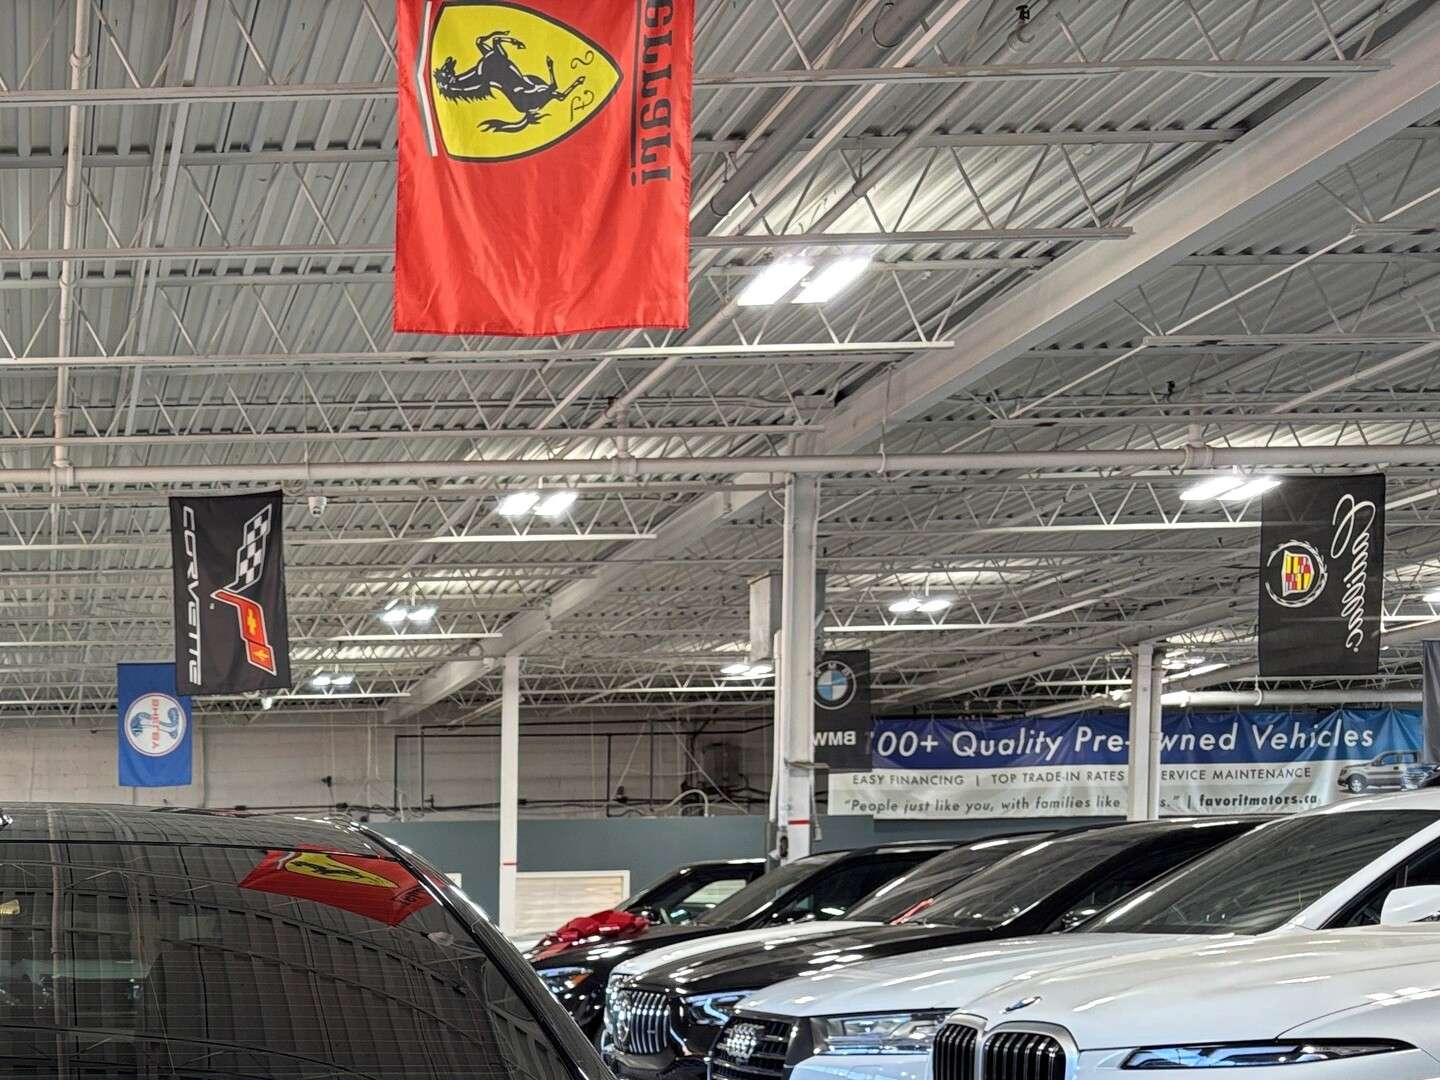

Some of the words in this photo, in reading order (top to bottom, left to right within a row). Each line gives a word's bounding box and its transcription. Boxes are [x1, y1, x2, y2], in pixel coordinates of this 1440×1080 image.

[183, 505, 202, 686] CORVETTE
[865, 731, 939, 757] 00+
[952, 727, 1063, 761] Quality
[1074, 721, 1239, 753] Pre-wned
[1251, 718, 1374, 750] Vehicles
[852, 774, 885, 785] EASY
[890, 774, 965, 786] FINANCING
[991, 773, 1017, 785] TOP
[1023, 771, 1081, 783] TRADE-IN
[1087, 770, 1126, 782] RATES
[1160, 769, 1207, 781] ERVICE
[1212, 767, 1312, 781] MAINTENANCE
[903, 800, 931, 814] just
[935, 799, 961, 812] like
[965, 801, 994, 814] you,
[1001, 797, 1030, 810] with
[1035, 796, 1091, 809] families
[1096, 795, 1121, 809] like
[1199, 793, 1318, 807] favoritmotors.ca
